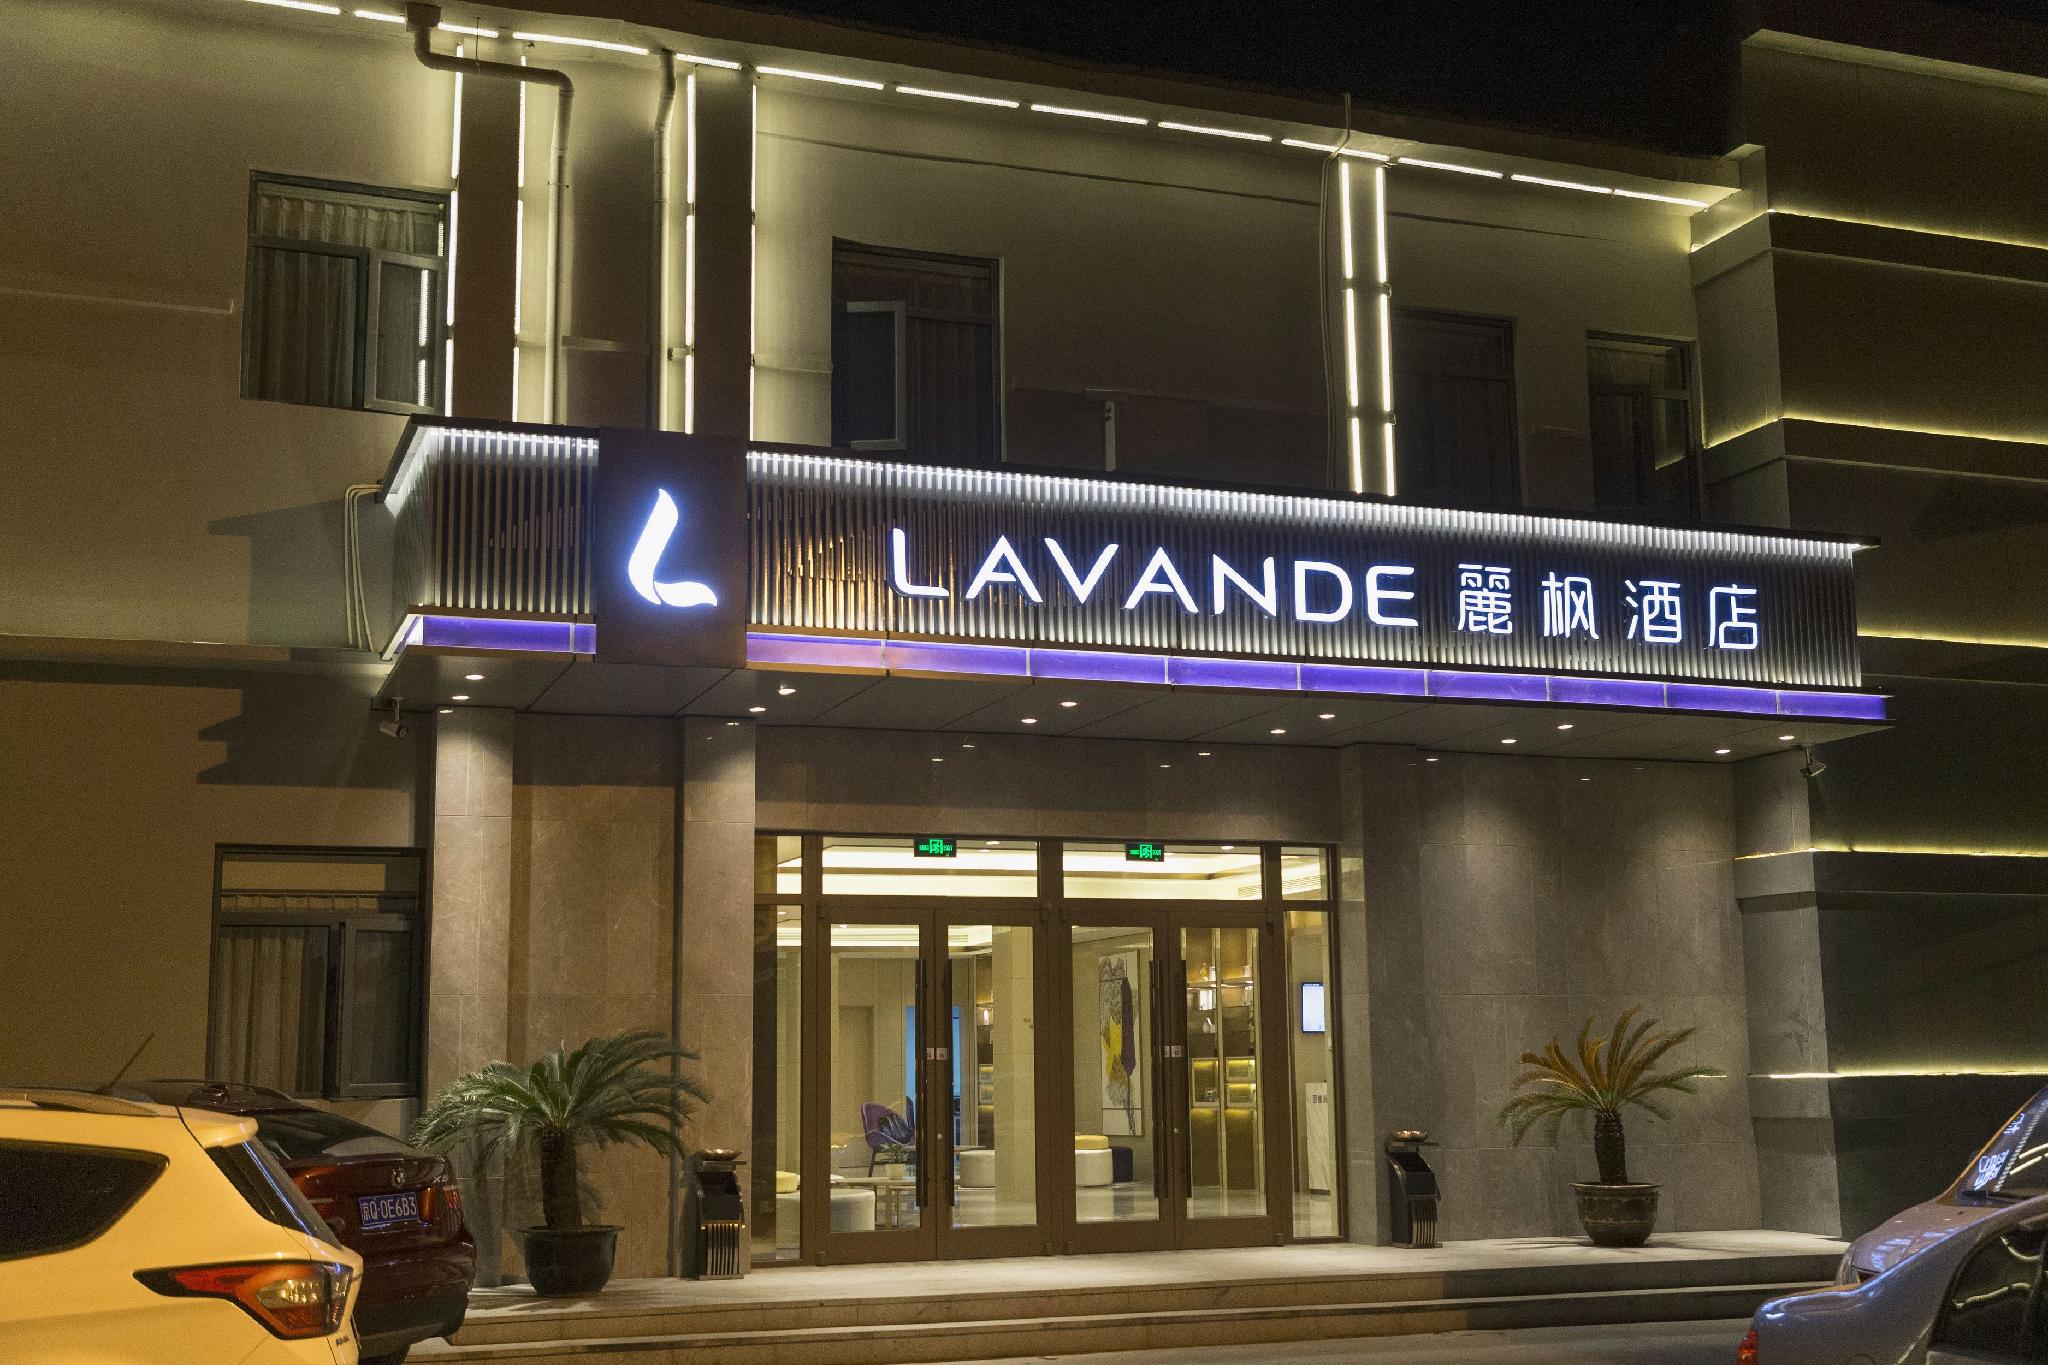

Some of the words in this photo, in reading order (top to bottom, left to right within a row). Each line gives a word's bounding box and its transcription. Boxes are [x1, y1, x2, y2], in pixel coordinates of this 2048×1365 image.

[892, 527, 1420, 630] LAVANDE
[1456, 562, 1760, 651] 麗枫酒店
